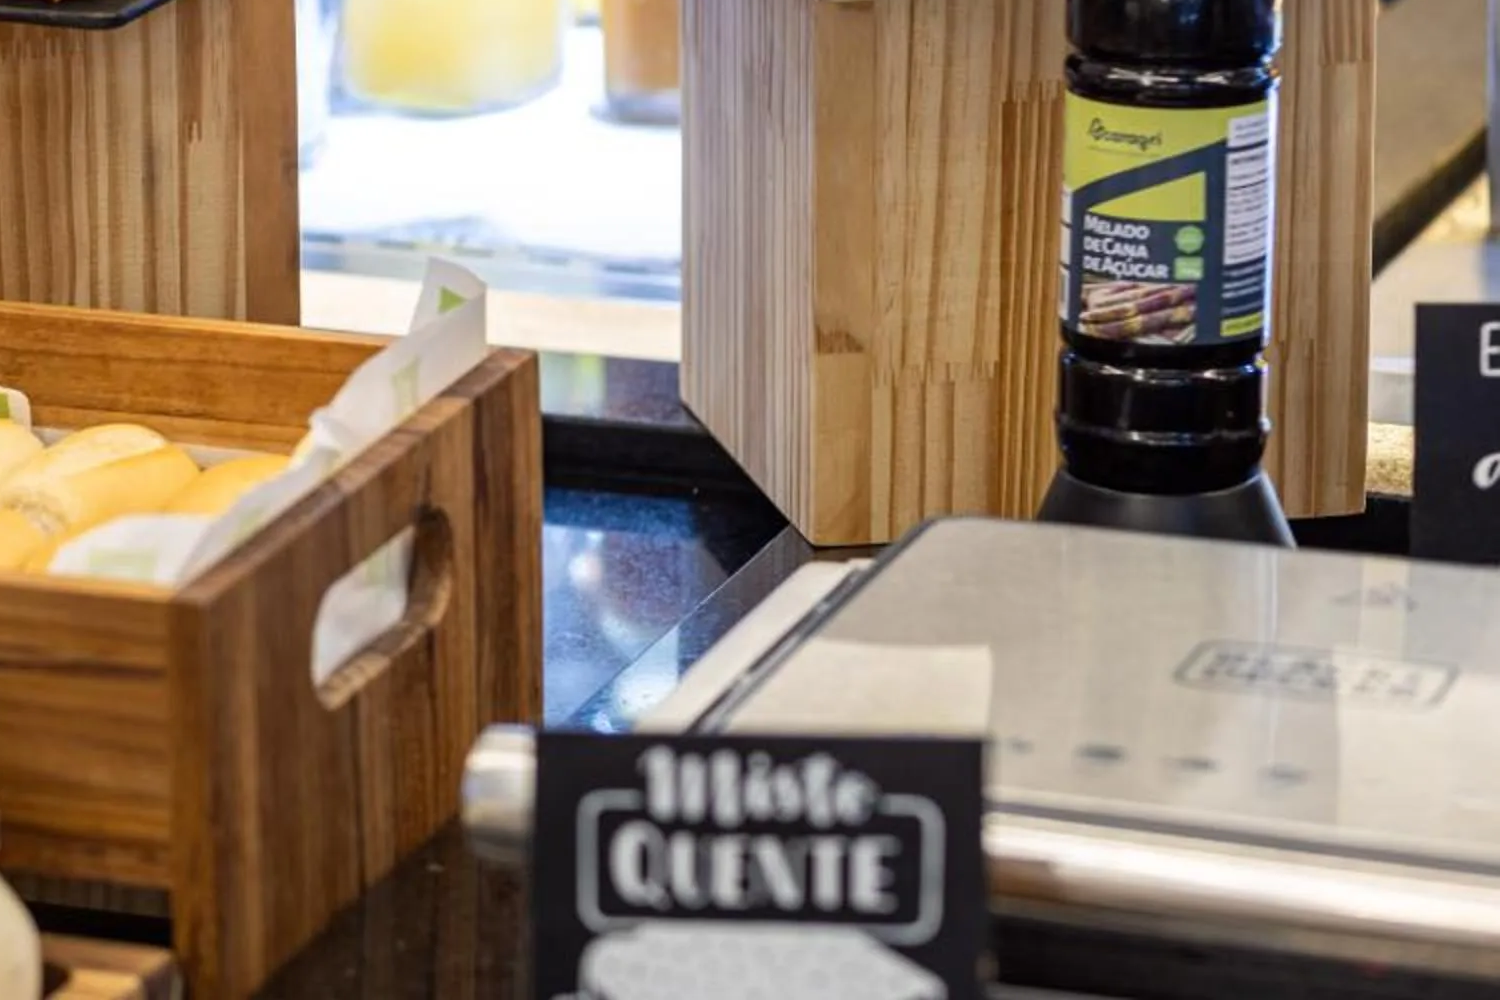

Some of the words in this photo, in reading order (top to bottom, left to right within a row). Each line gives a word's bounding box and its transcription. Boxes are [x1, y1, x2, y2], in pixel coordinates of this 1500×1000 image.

[1083, 213, 1151, 240] MELADO
[1102, 254, 1170, 281] AÇÚCAR
[609, 818, 901, 914] QUENTE
